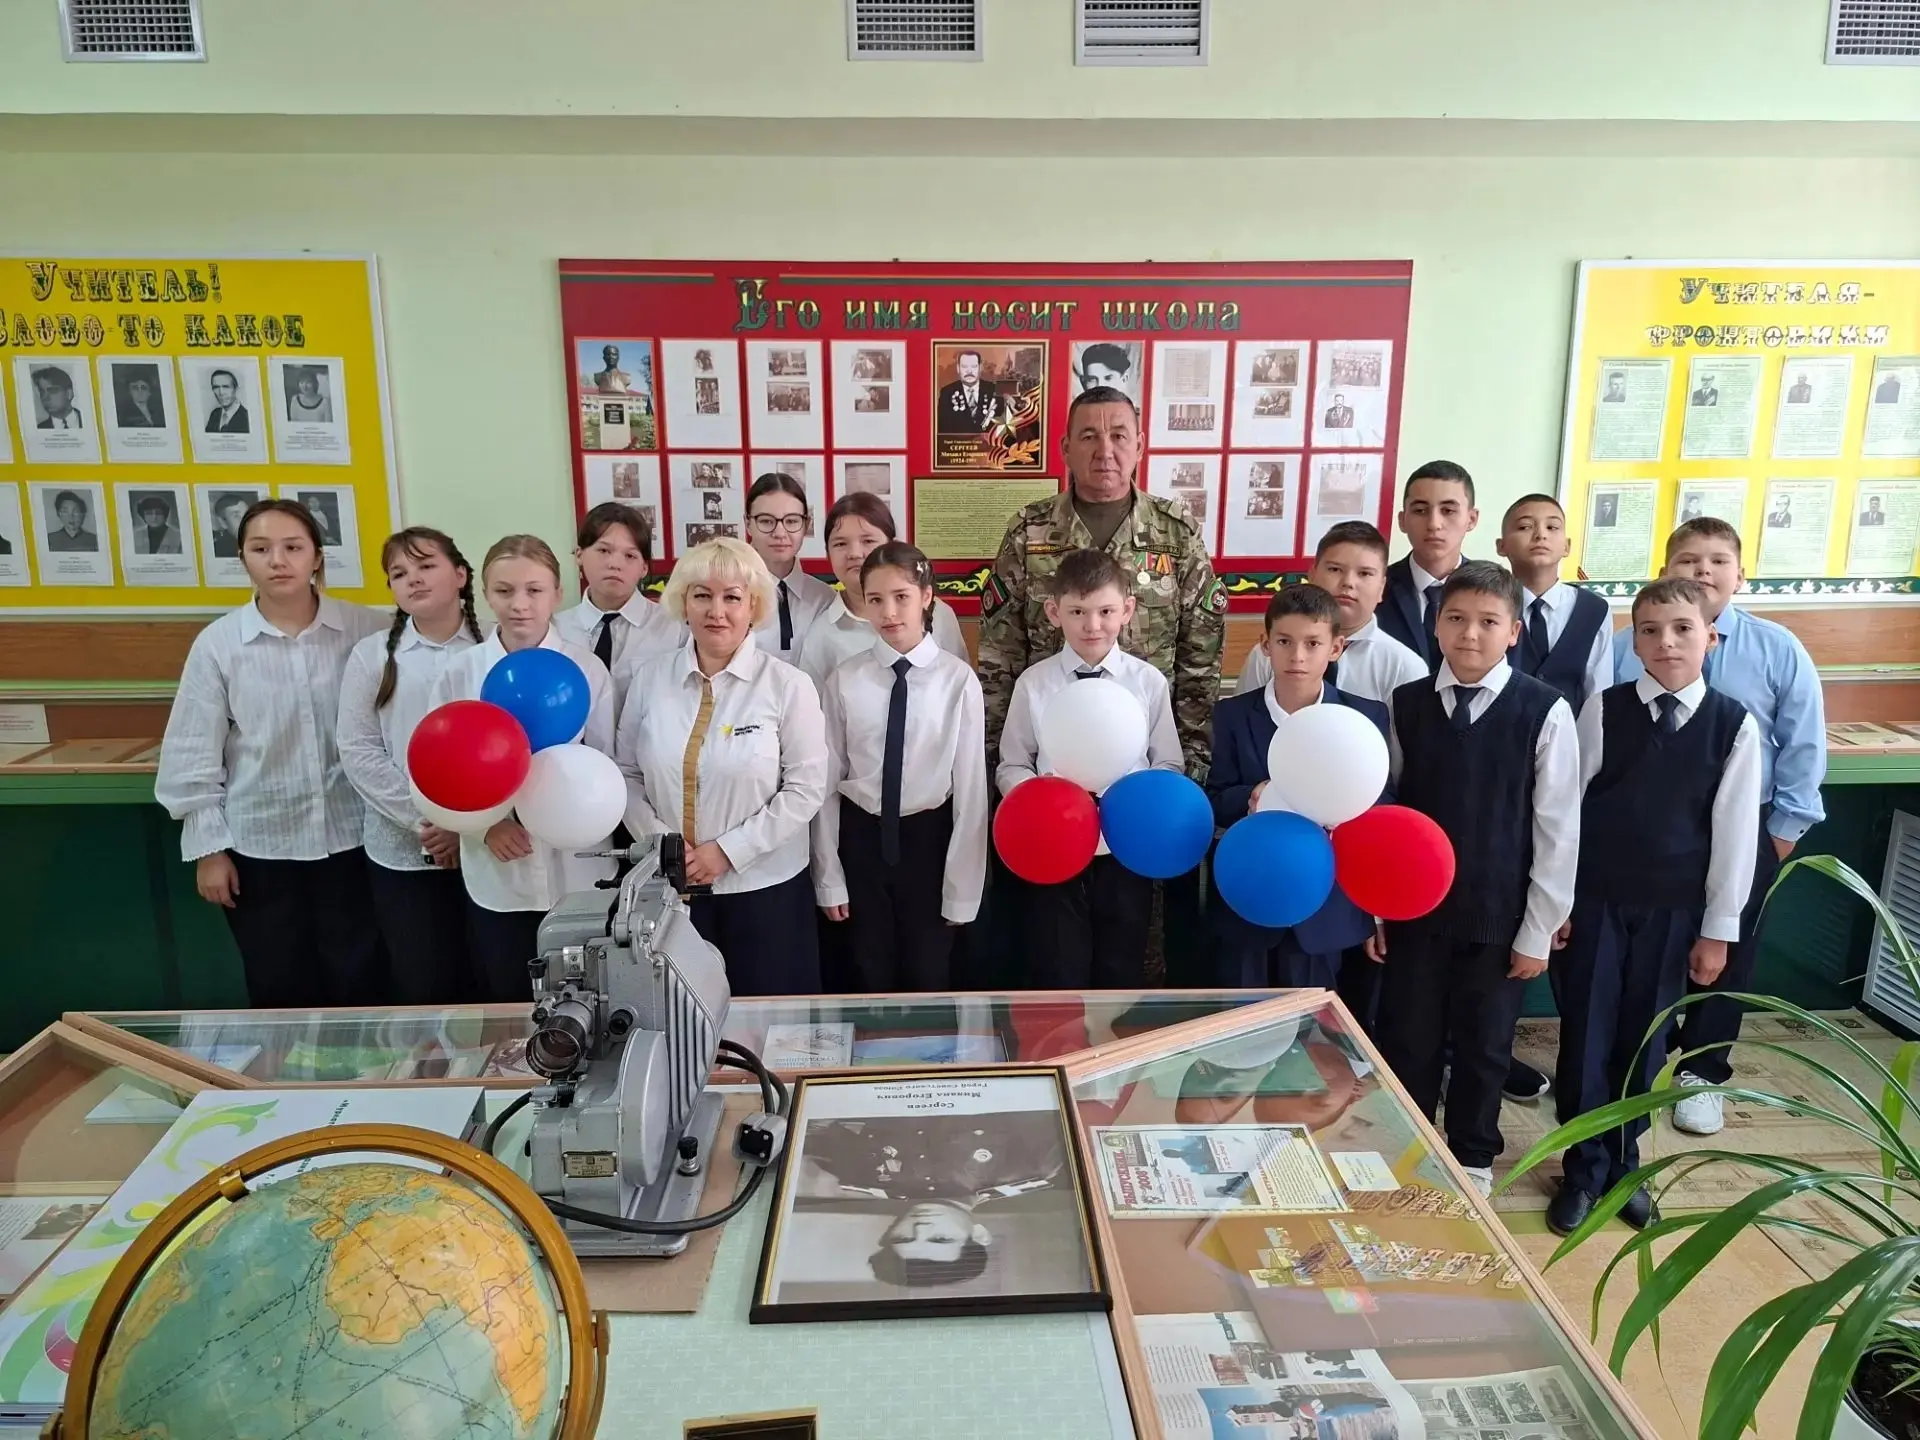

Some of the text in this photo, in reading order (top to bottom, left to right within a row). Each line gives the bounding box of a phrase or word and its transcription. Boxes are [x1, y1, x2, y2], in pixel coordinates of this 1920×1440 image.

[25, 261, 222, 303] УЧИТЕЛЬ!
[733, 277, 1241, 332] Его имя носит школа
[183, 313, 306, 348] КАКОЕ
[1644, 324, 1890, 348] ФРОНТОВИКИ
